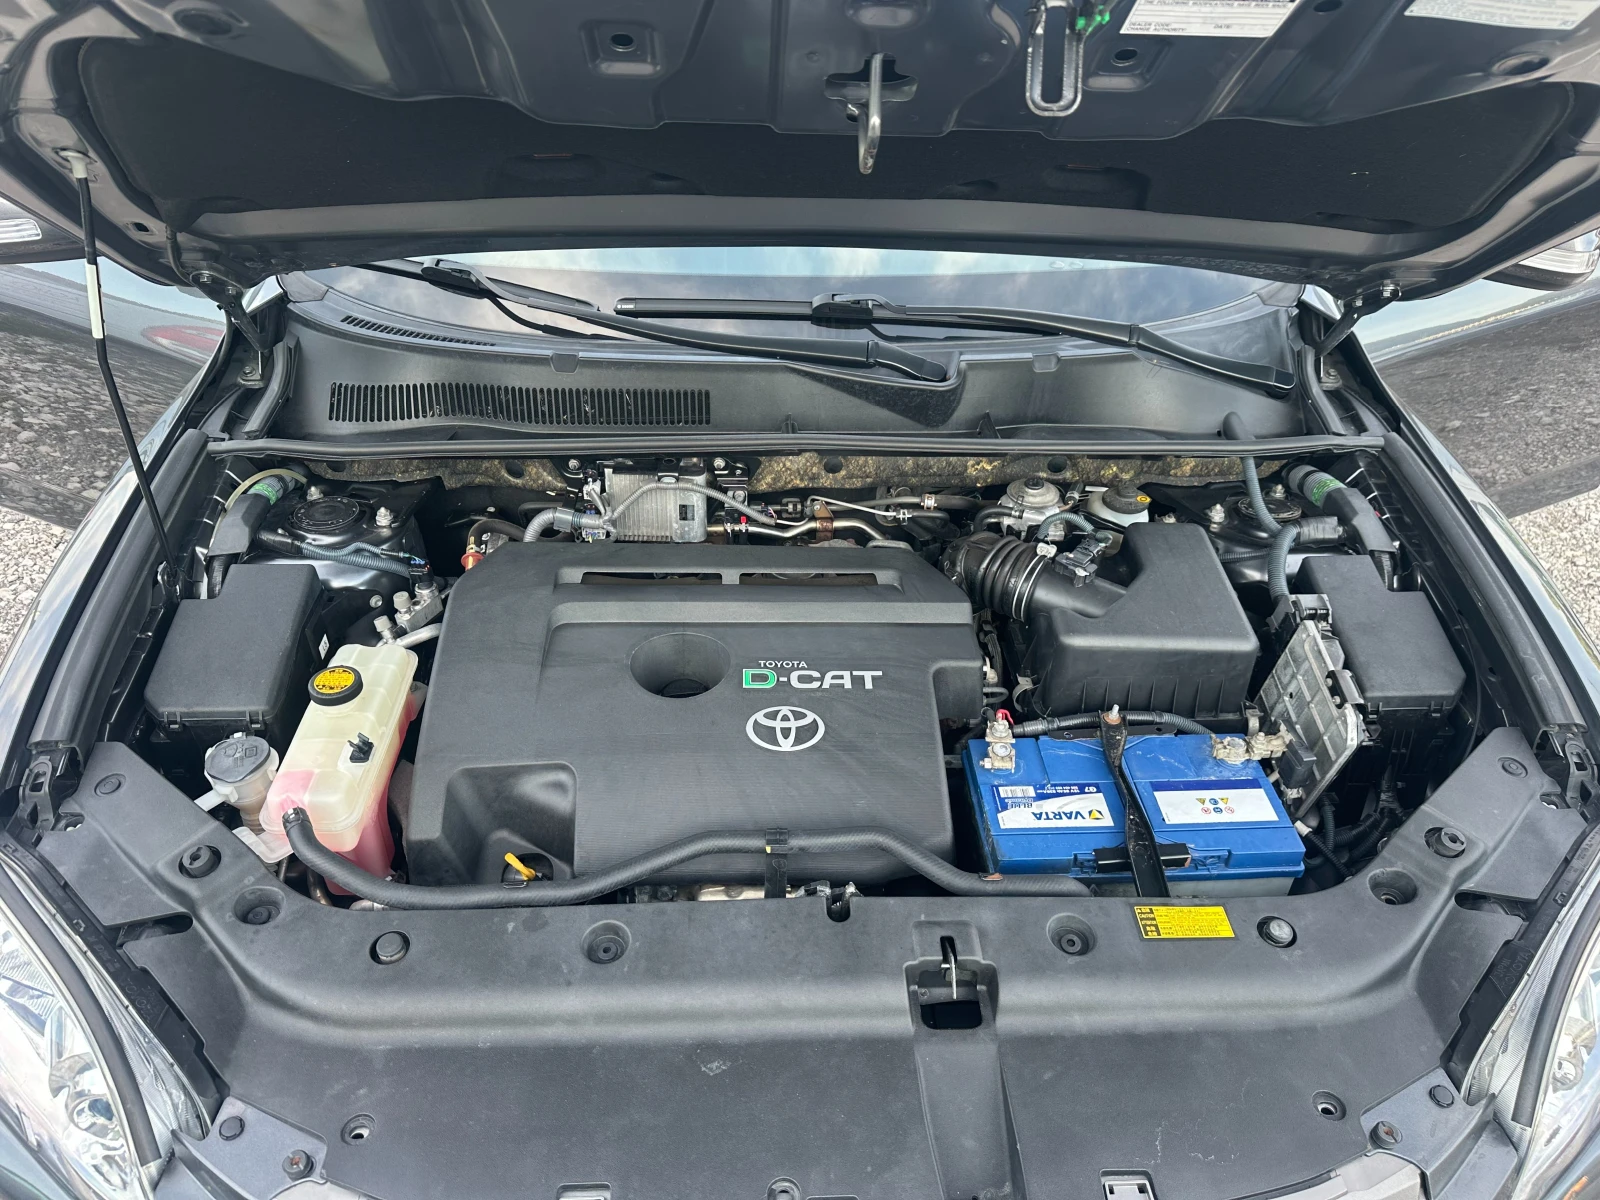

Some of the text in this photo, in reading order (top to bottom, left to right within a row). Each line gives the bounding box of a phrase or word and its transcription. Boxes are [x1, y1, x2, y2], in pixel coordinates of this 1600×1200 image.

[758, 660, 808, 668] TOYOTA
[742, 669, 883, 689] D-CAT
[1031, 811, 1086, 820] VARTA
